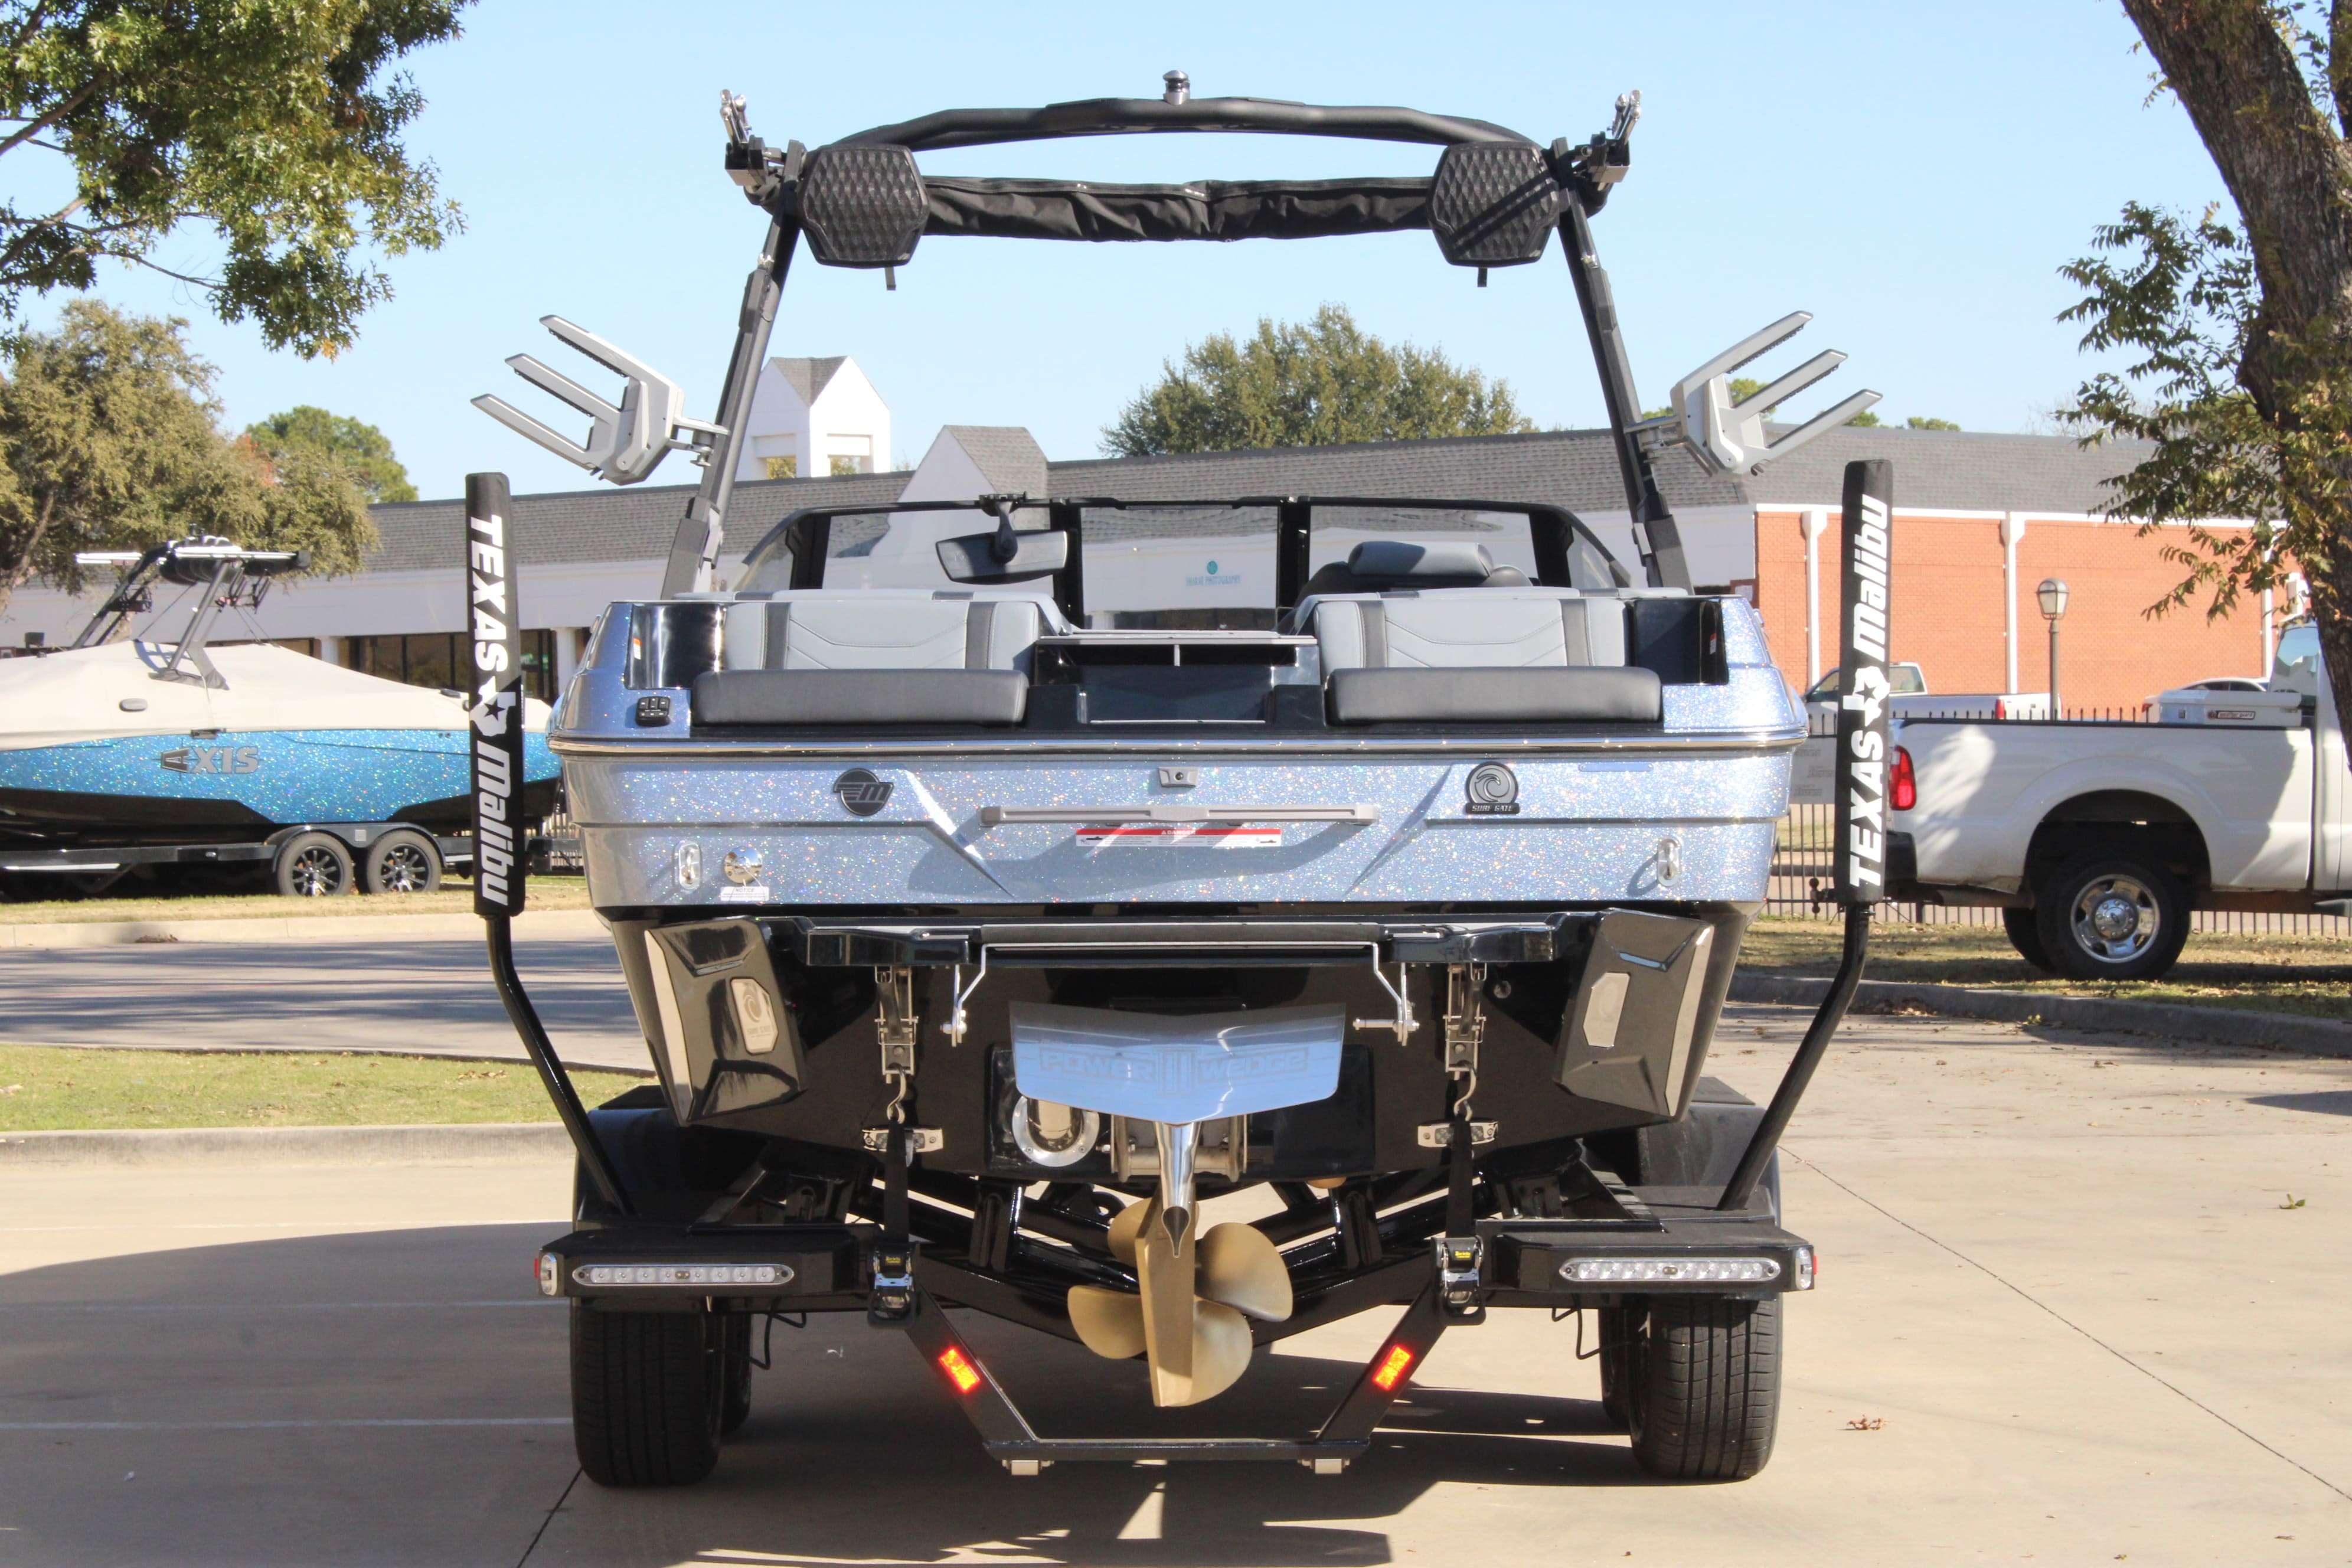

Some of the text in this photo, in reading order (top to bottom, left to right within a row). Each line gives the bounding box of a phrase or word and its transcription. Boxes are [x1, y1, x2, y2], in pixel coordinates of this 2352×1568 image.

[161, 746, 259, 775] AXIS
[471, 514, 514, 906] TEXAS Malibu
[1850, 494, 1887, 887] TEXAS Malibu
